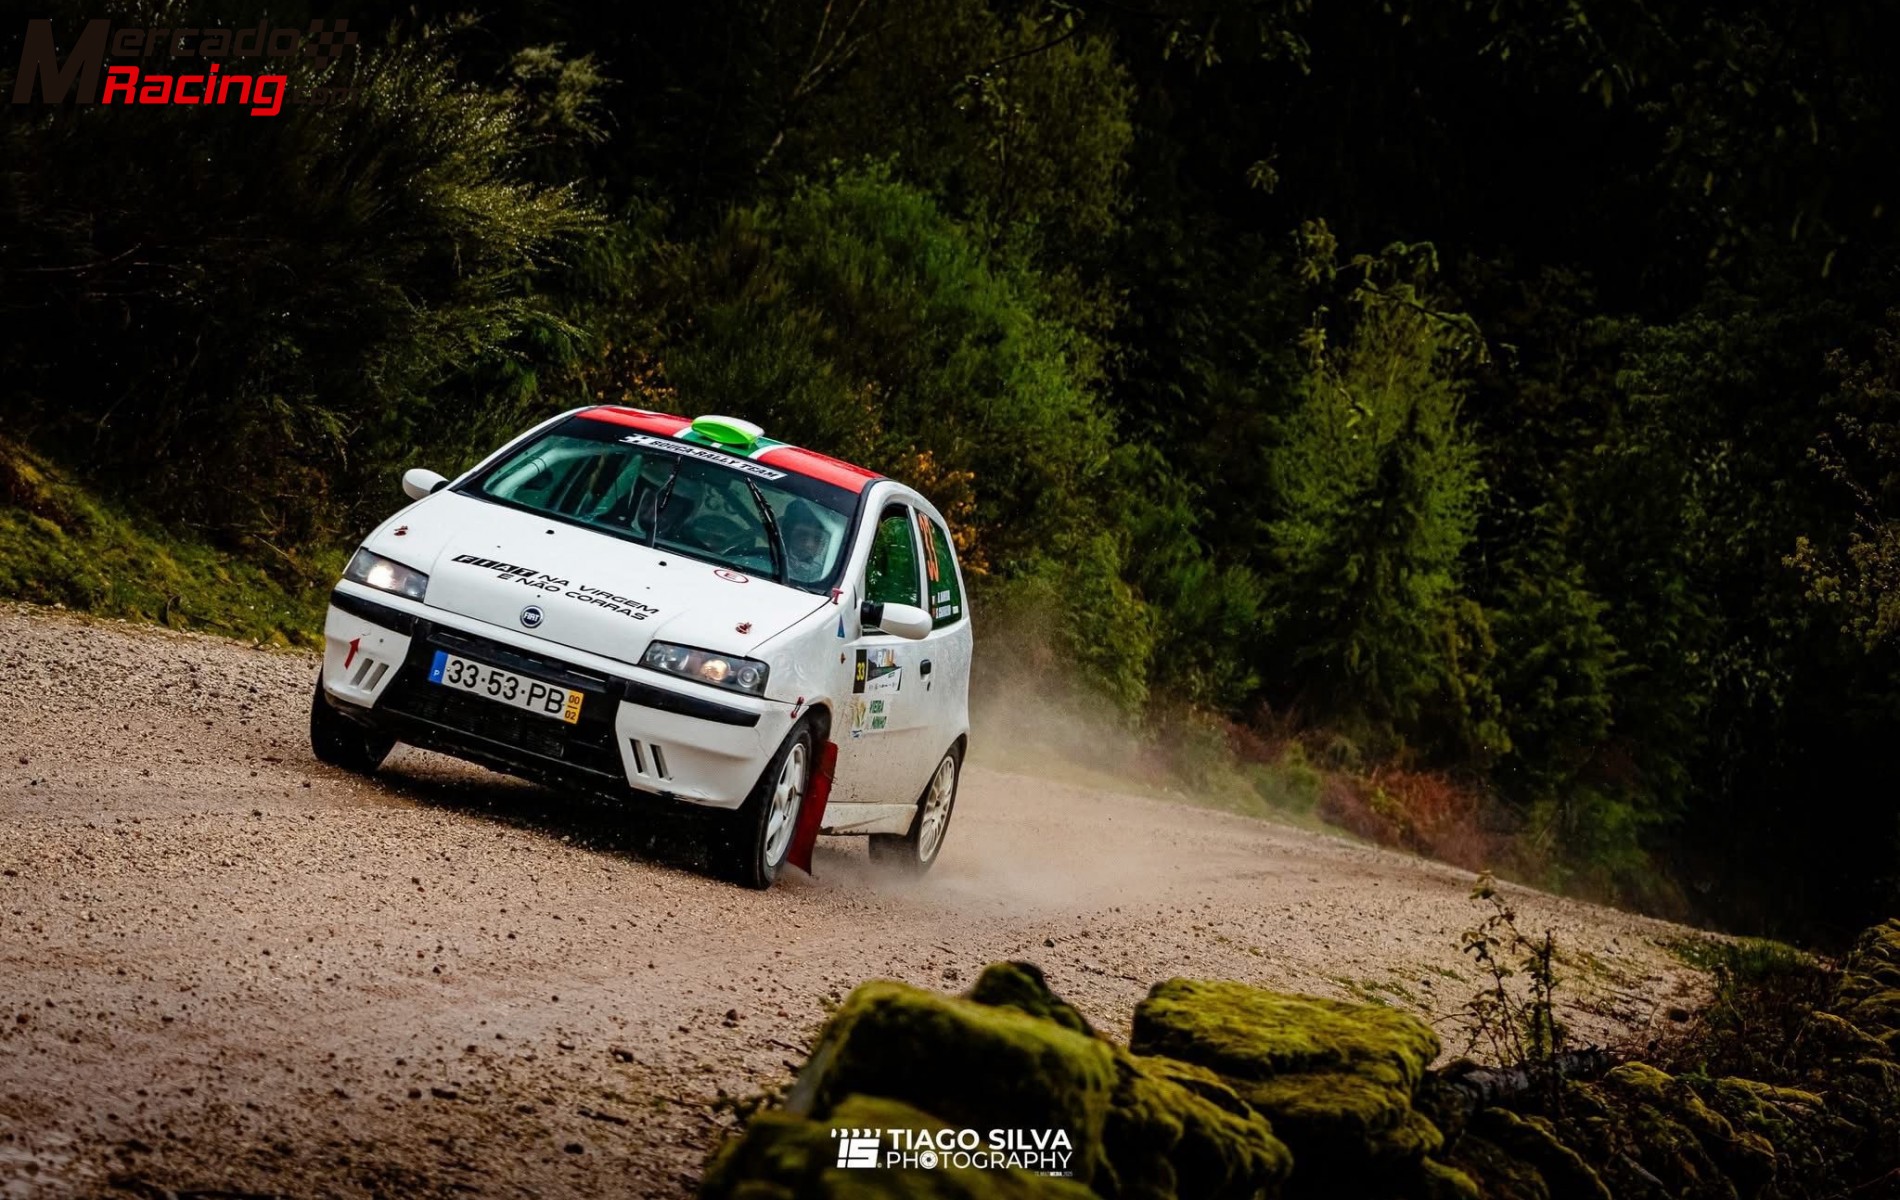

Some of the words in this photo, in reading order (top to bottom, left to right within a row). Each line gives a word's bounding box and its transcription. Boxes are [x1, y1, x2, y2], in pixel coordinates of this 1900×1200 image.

[738, 462, 778, 478] TEAM
[451, 554, 540, 578] FIAT
[538, 574, 570, 587] NA
[579, 585, 660, 615] VIRGEM
[497, 573, 515, 581] E
[515, 577, 561, 593] NÃO
[564, 590, 649, 621] CORRAS
[523, 611, 540, 624] FIAT
[568, 694, 581, 705] 00
[564, 709, 577, 720] 02
